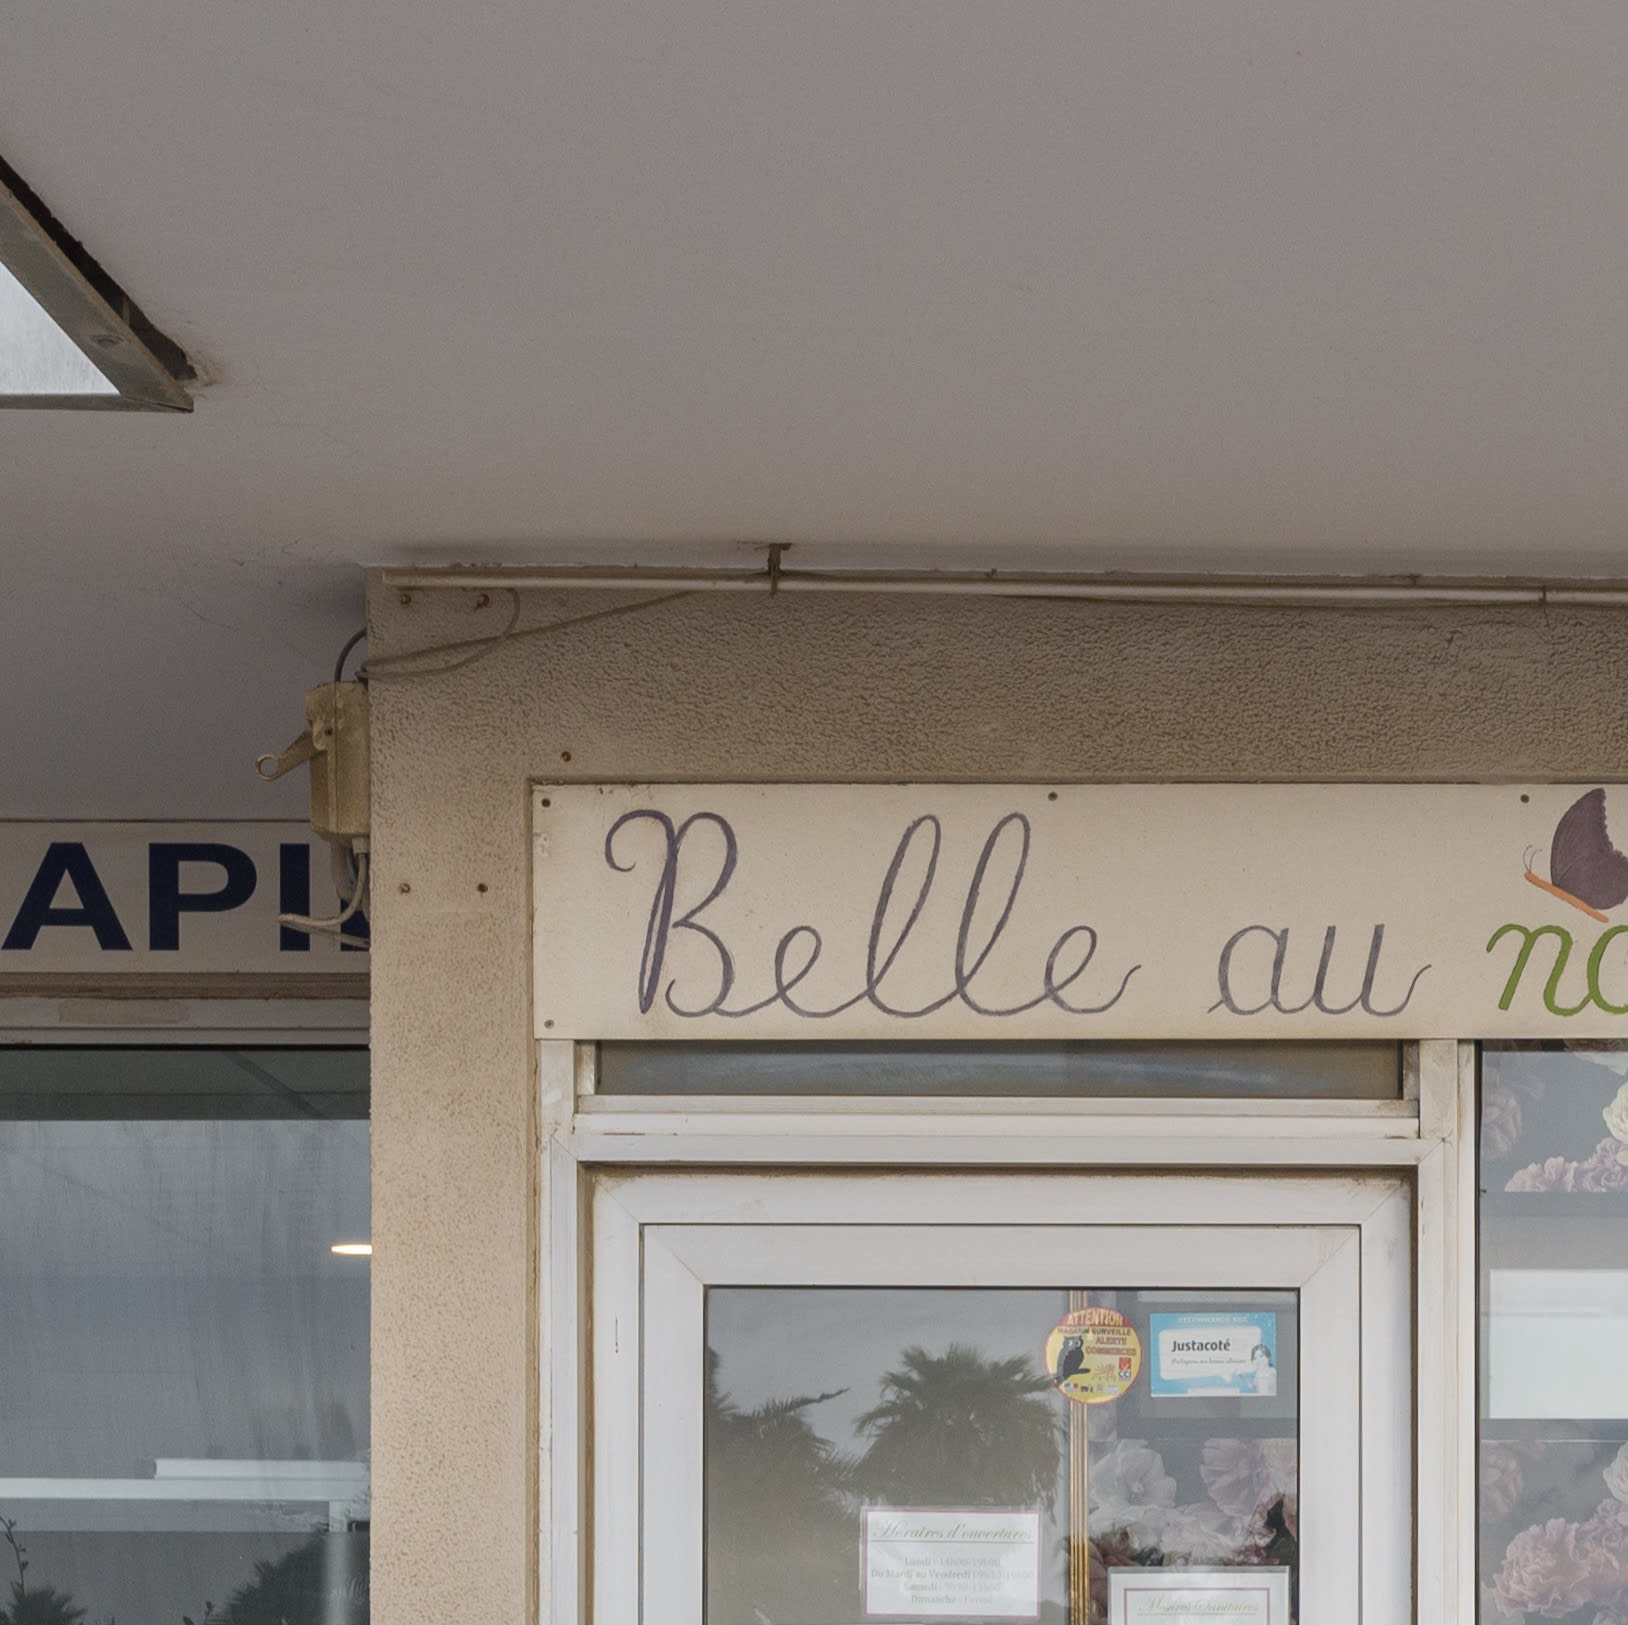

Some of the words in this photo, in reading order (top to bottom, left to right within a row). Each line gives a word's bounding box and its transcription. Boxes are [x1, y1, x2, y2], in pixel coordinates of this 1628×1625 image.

[604, 808, 1142, 1020] Belle
[1206, 922, 1432, 1017] au
[1066, 1308, 1124, 1327] ATTENTION
[1171, 1338, 1232, 1353] Justacoté
